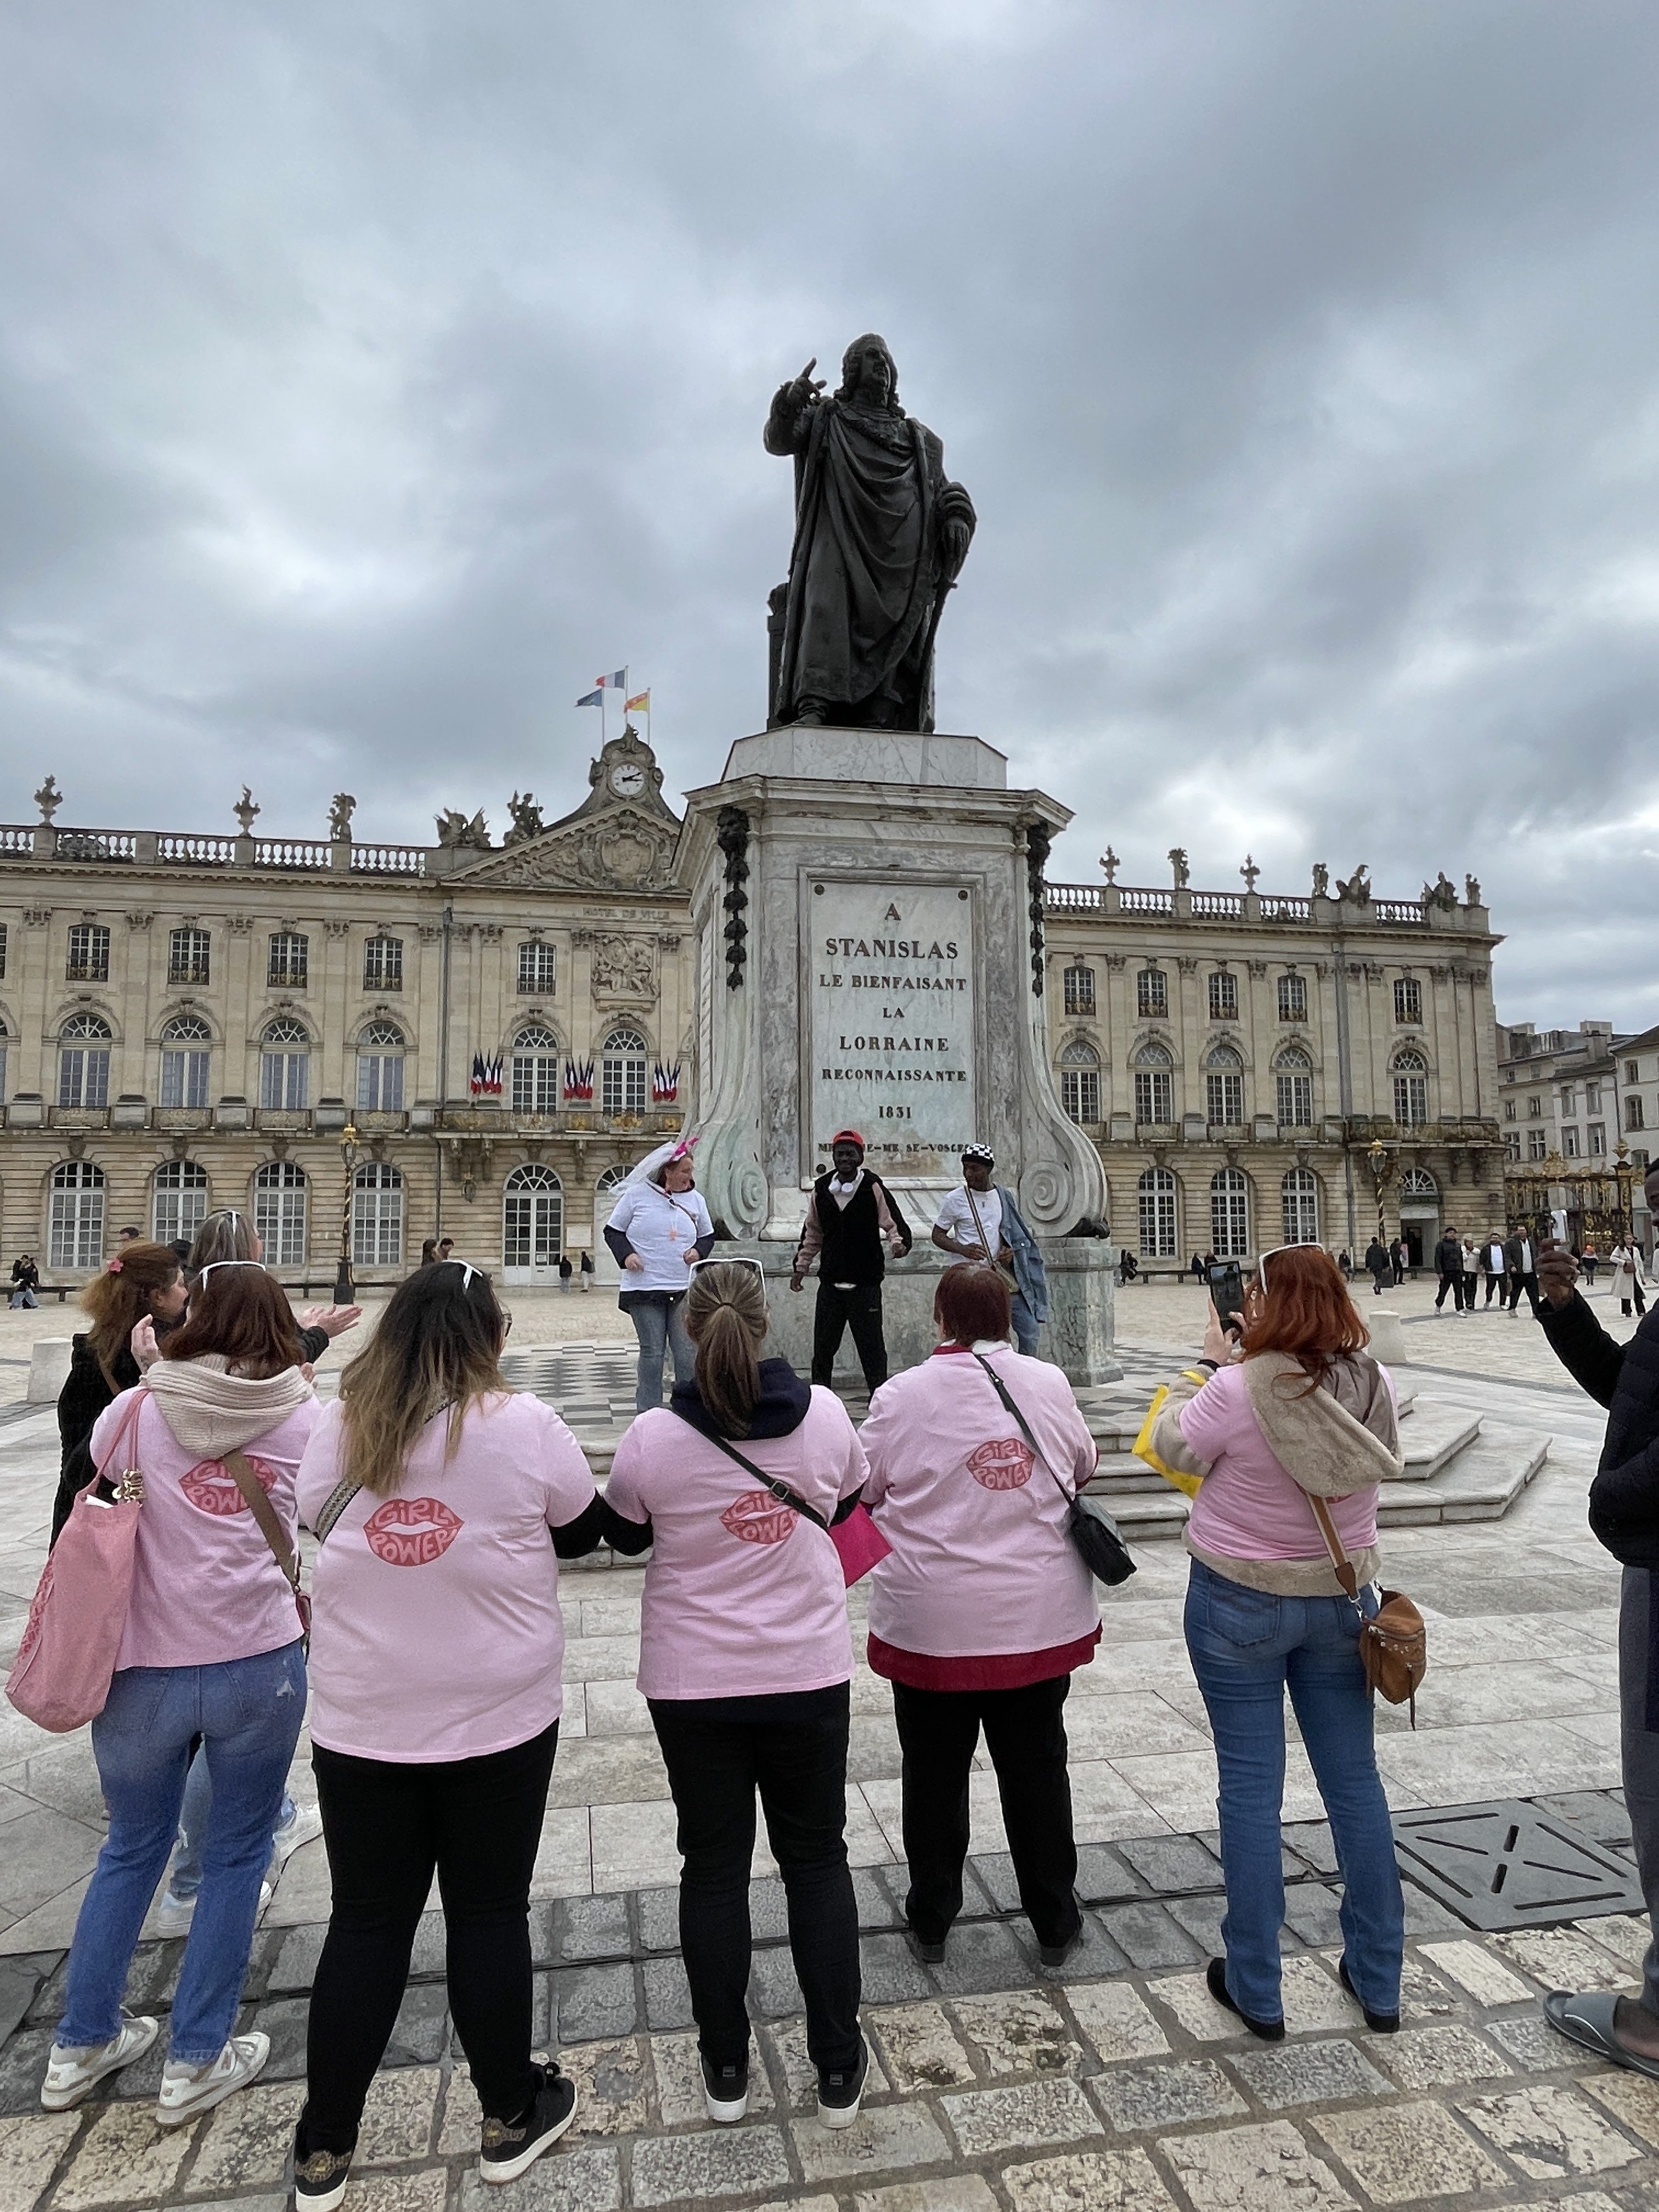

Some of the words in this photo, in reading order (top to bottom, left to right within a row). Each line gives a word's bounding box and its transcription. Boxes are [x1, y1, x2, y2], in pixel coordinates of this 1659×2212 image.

[884, 902, 901, 921] A
[826, 938, 958, 959] STANISLAS
[820, 974, 843, 988] LE
[851, 975, 967, 990] BIENFAISANT
[883, 1007, 905, 1018] LA
[839, 1036, 949, 1051] LORRAINE
[822, 1069, 966, 1082] RECONNAISSANTE
[879, 1106, 911, 1119] 1831
[973, 1461, 1032, 1489] POWER
[370, 1528, 458, 1564] POWER
